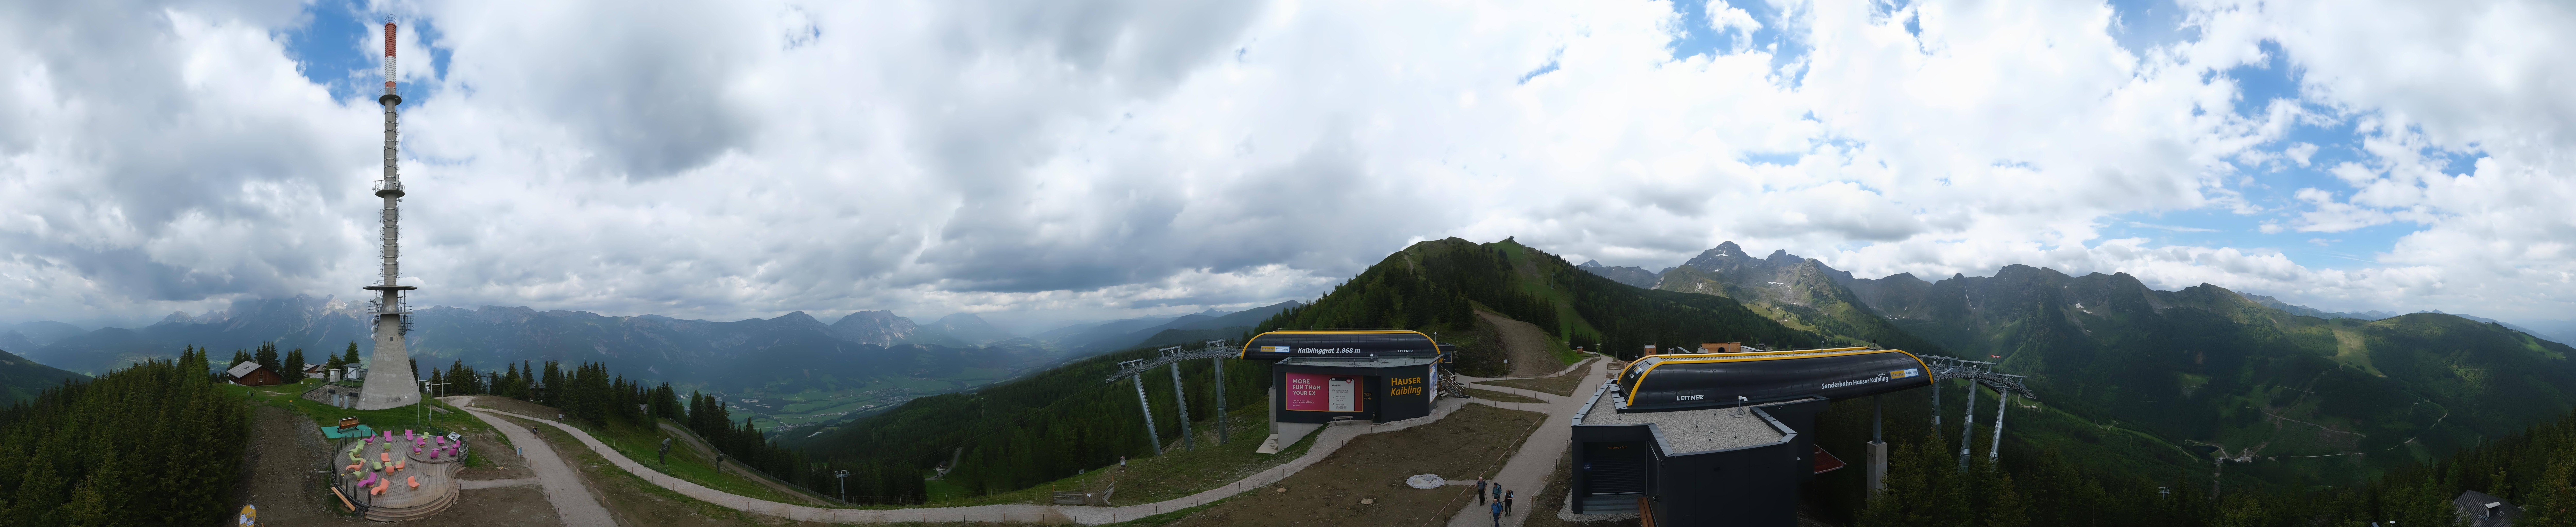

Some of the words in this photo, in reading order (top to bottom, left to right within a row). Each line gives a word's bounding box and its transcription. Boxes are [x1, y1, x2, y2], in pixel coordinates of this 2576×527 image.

[1391, 377, 1421, 386] HAUSER
[1822, 380, 1852, 389] Senderbahn
[1391, 386, 1421, 396] Kaibling
